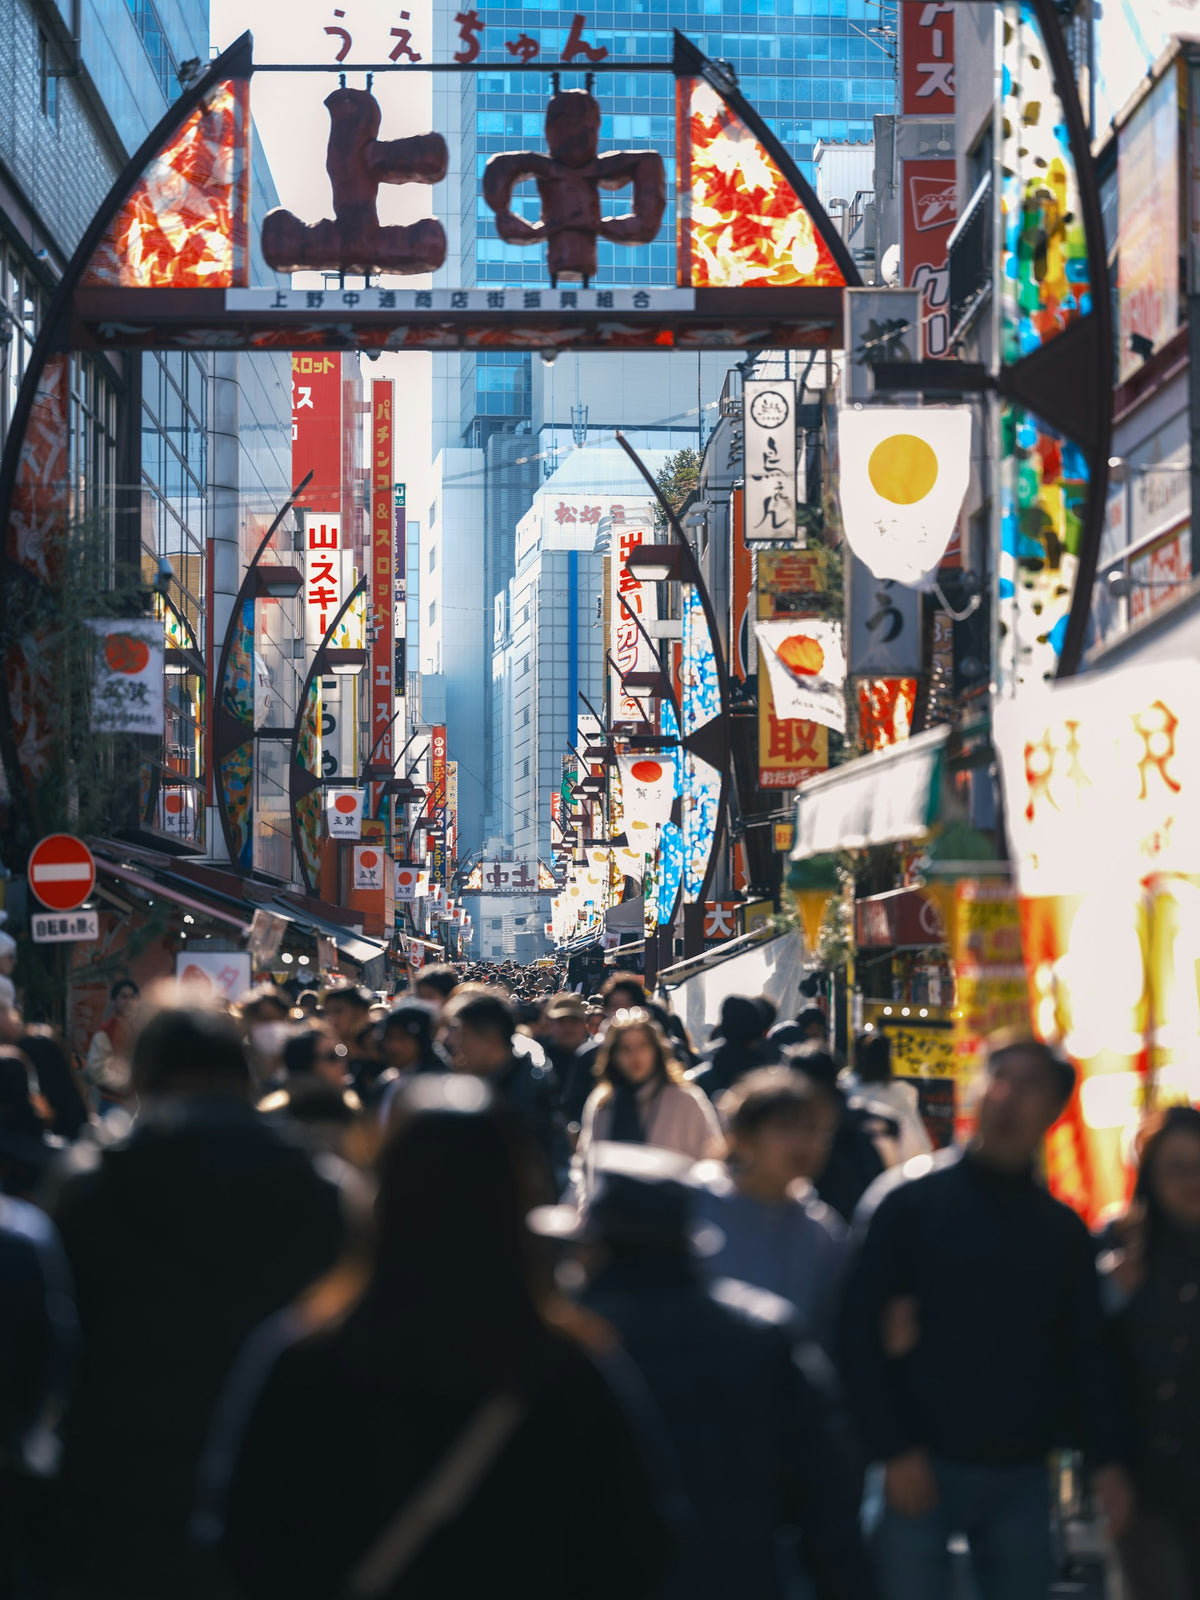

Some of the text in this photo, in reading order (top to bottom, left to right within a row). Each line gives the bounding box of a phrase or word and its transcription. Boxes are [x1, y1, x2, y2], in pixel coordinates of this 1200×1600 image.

[323, 9, 609, 63] うえちゅん
[261, 87, 666, 282] 上中
[270, 290, 651, 309] 上野中通商店街振興組合
[36, 918, 95, 938] 自転車を除く
